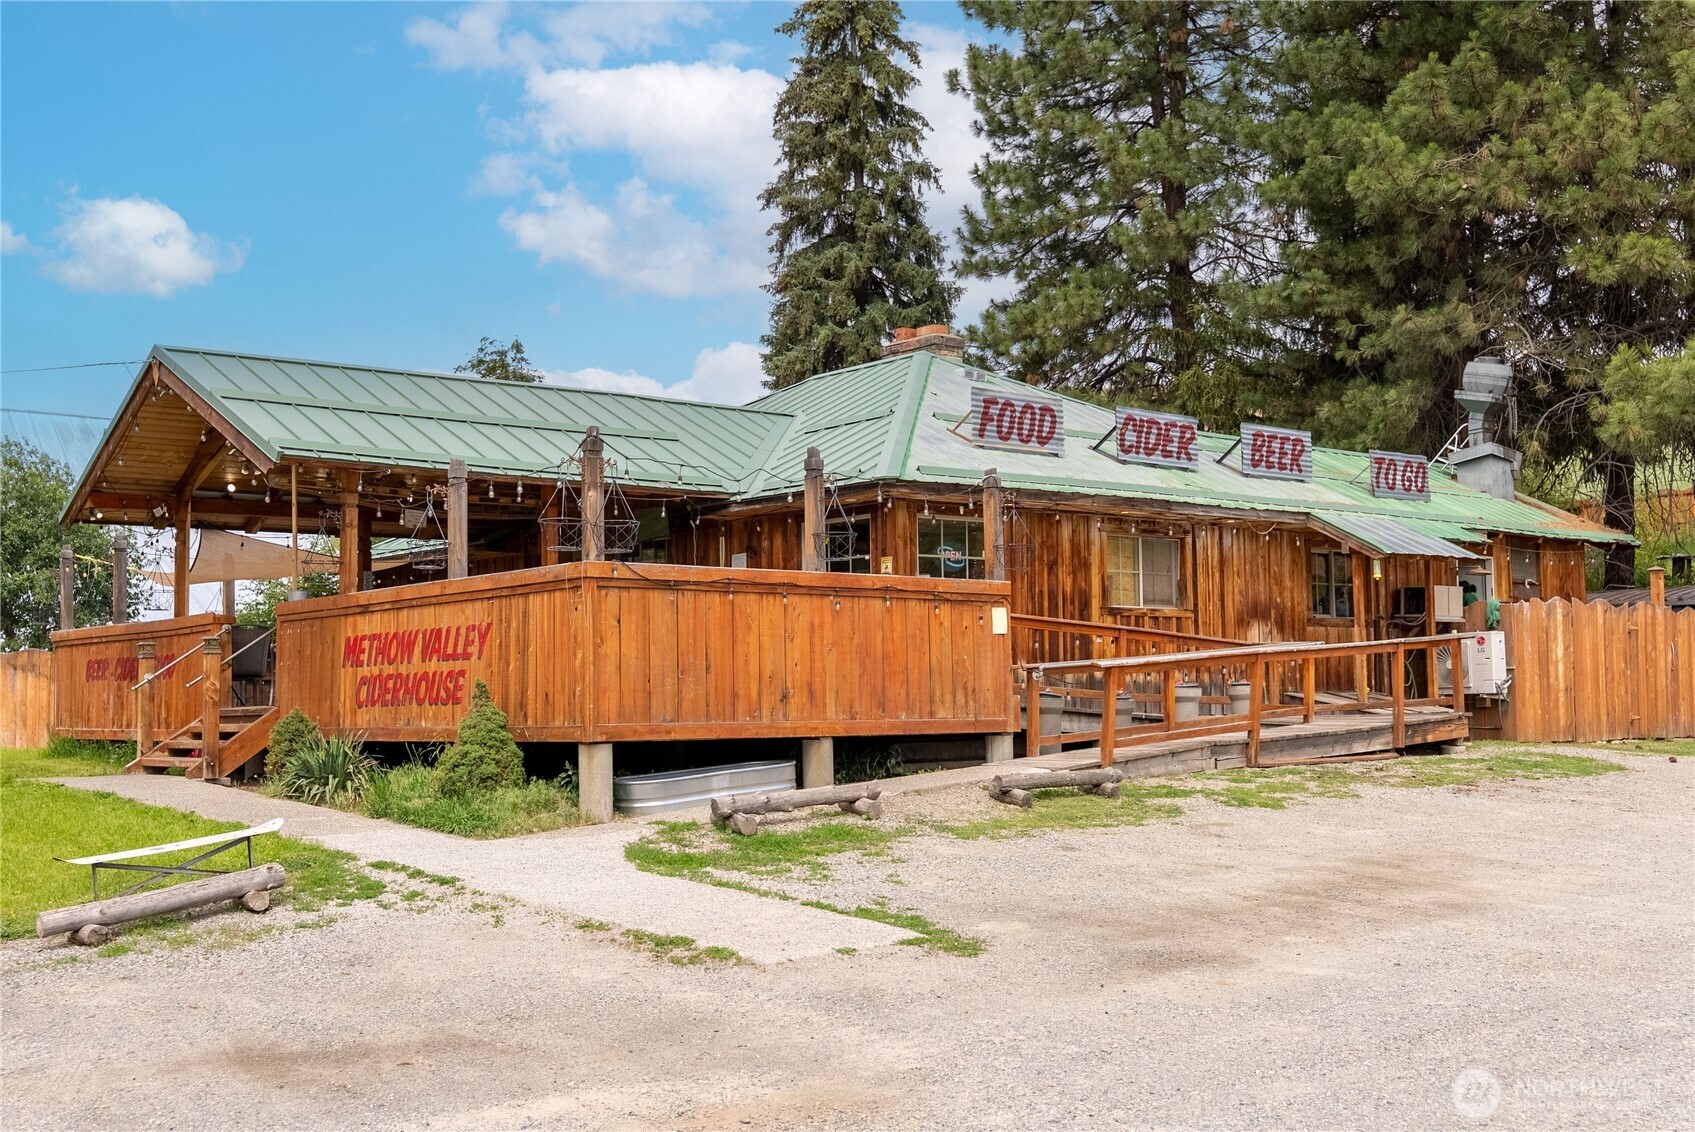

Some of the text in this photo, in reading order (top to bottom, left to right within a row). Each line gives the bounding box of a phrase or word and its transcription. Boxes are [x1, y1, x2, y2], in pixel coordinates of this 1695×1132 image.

[978, 397, 1058, 447] FOOD
[1119, 413, 1197, 462] CIDER
[1250, 431, 1306, 474] BEER
[1372, 456, 1426, 494] TO GO
[342, 622, 493, 668] METHOW VALLEY
[115, 656, 139, 682] CIDE
[355, 669, 468, 710] CIDERHOUSE
